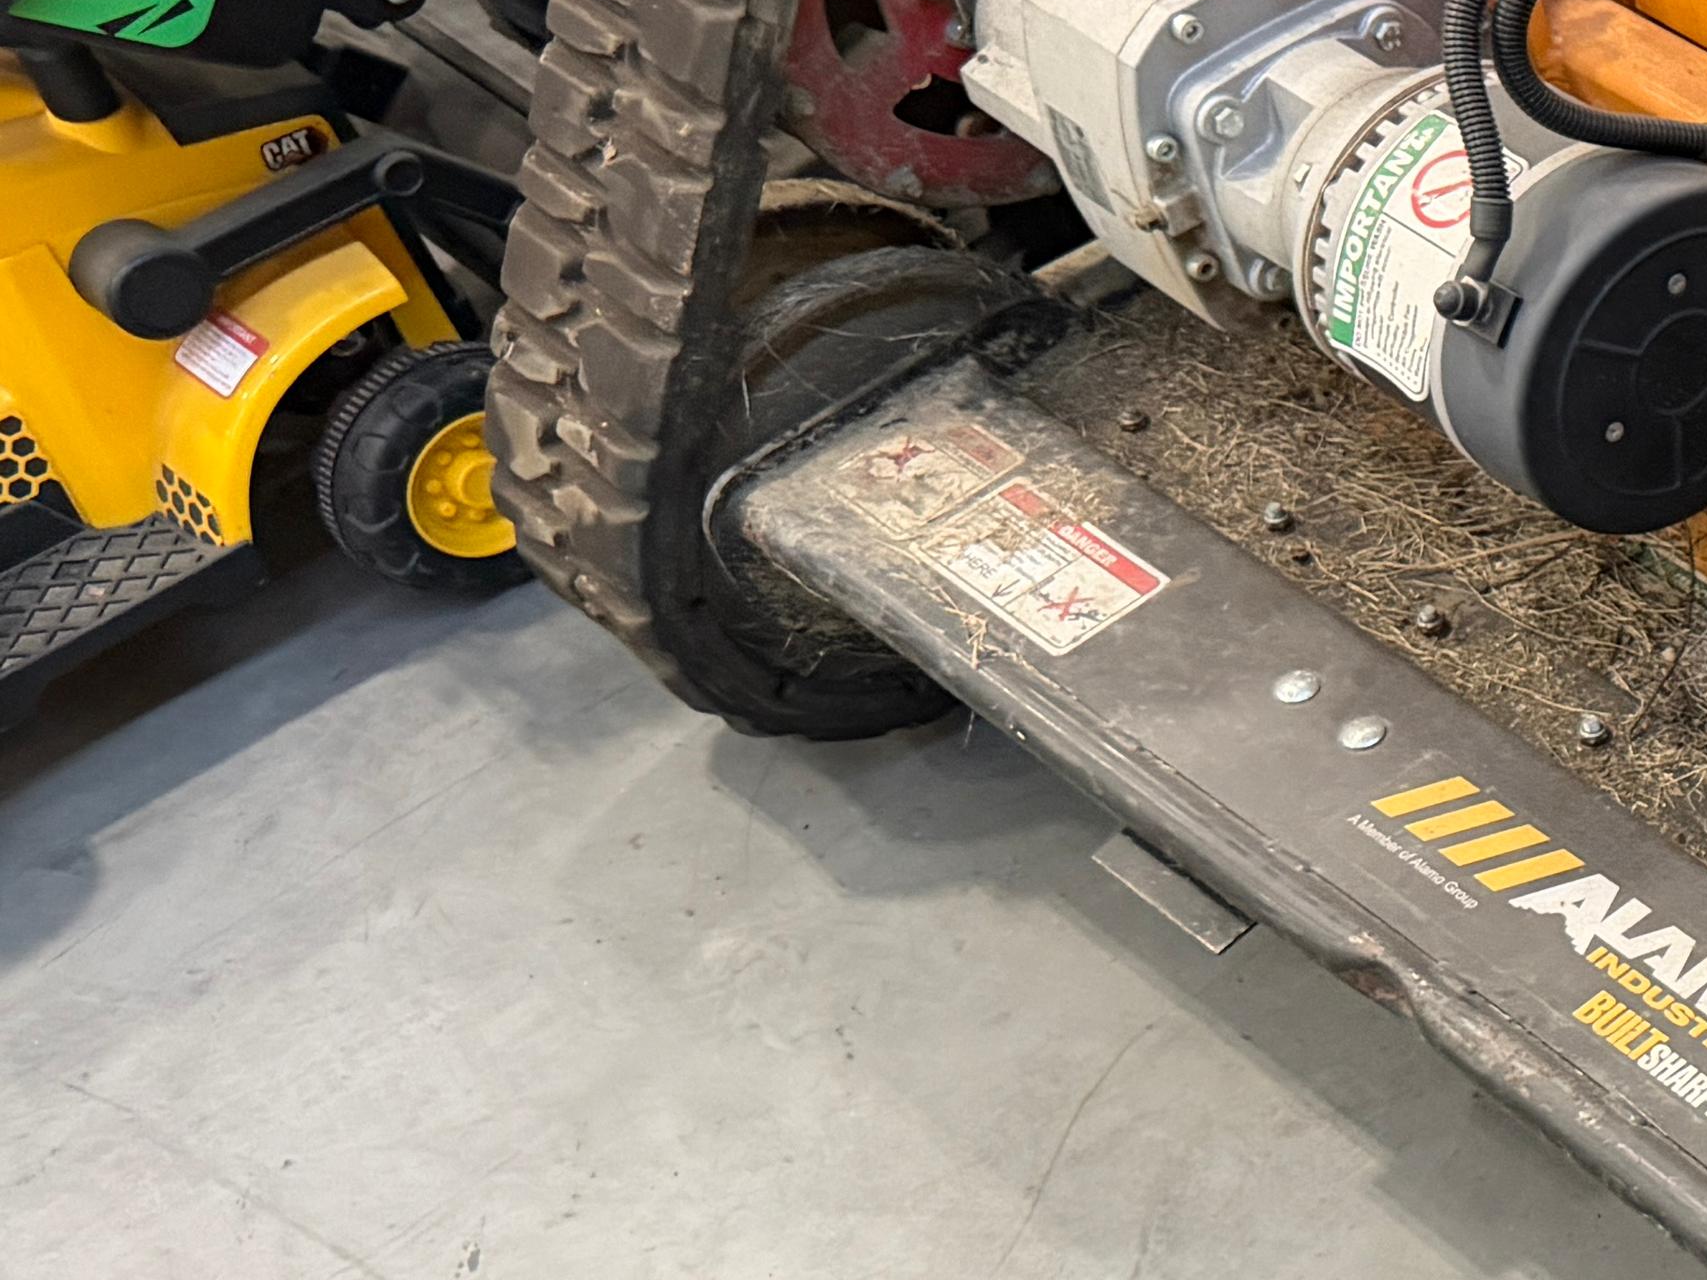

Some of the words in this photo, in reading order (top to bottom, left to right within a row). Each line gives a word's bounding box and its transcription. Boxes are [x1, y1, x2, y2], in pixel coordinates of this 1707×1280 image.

[262, 129, 312, 170] CAT
[964, 551, 997, 580] HERE
[1058, 524, 1118, 566] DANGER
[1346, 814, 1362, 826] A
[1357, 820, 1402, 853] Member
[1398, 849, 1417, 862] of
[1408, 858, 1446, 885] Alamo
[1444, 880, 1479, 910] Group
